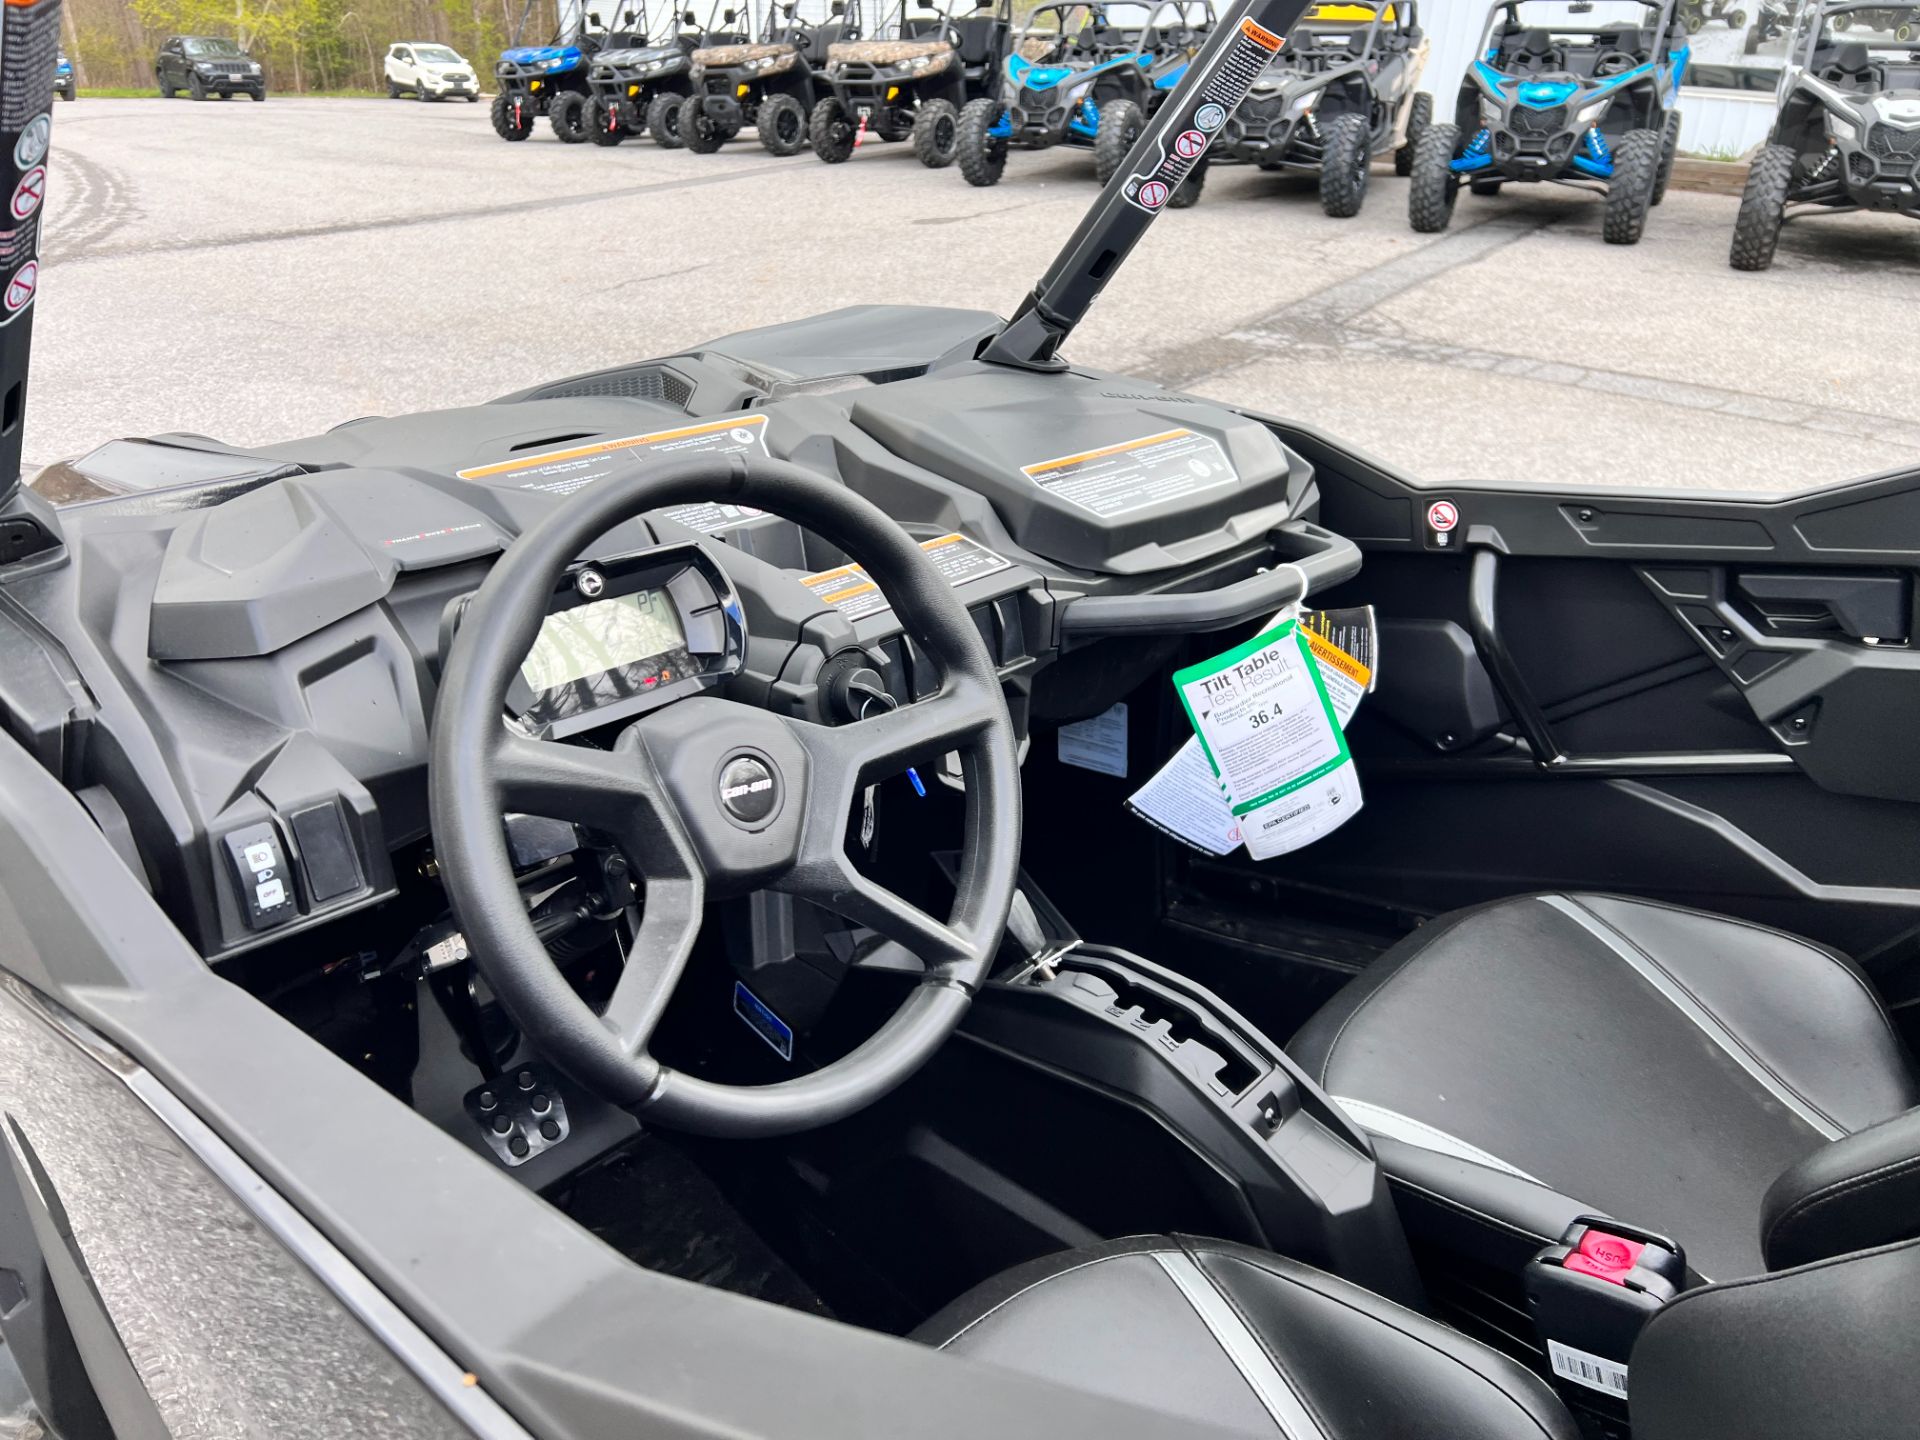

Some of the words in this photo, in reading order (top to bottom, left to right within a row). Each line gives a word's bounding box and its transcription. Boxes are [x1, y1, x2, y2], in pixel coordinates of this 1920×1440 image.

[1200, 674, 1232, 694] Tilt
[1232, 650, 1280, 679] Table
[1309, 641, 1359, 677] AVERTISSEMENT
[1203, 684, 1240, 708] Test
[1241, 657, 1291, 691] Result
[1249, 702, 1283, 729] 36.4
